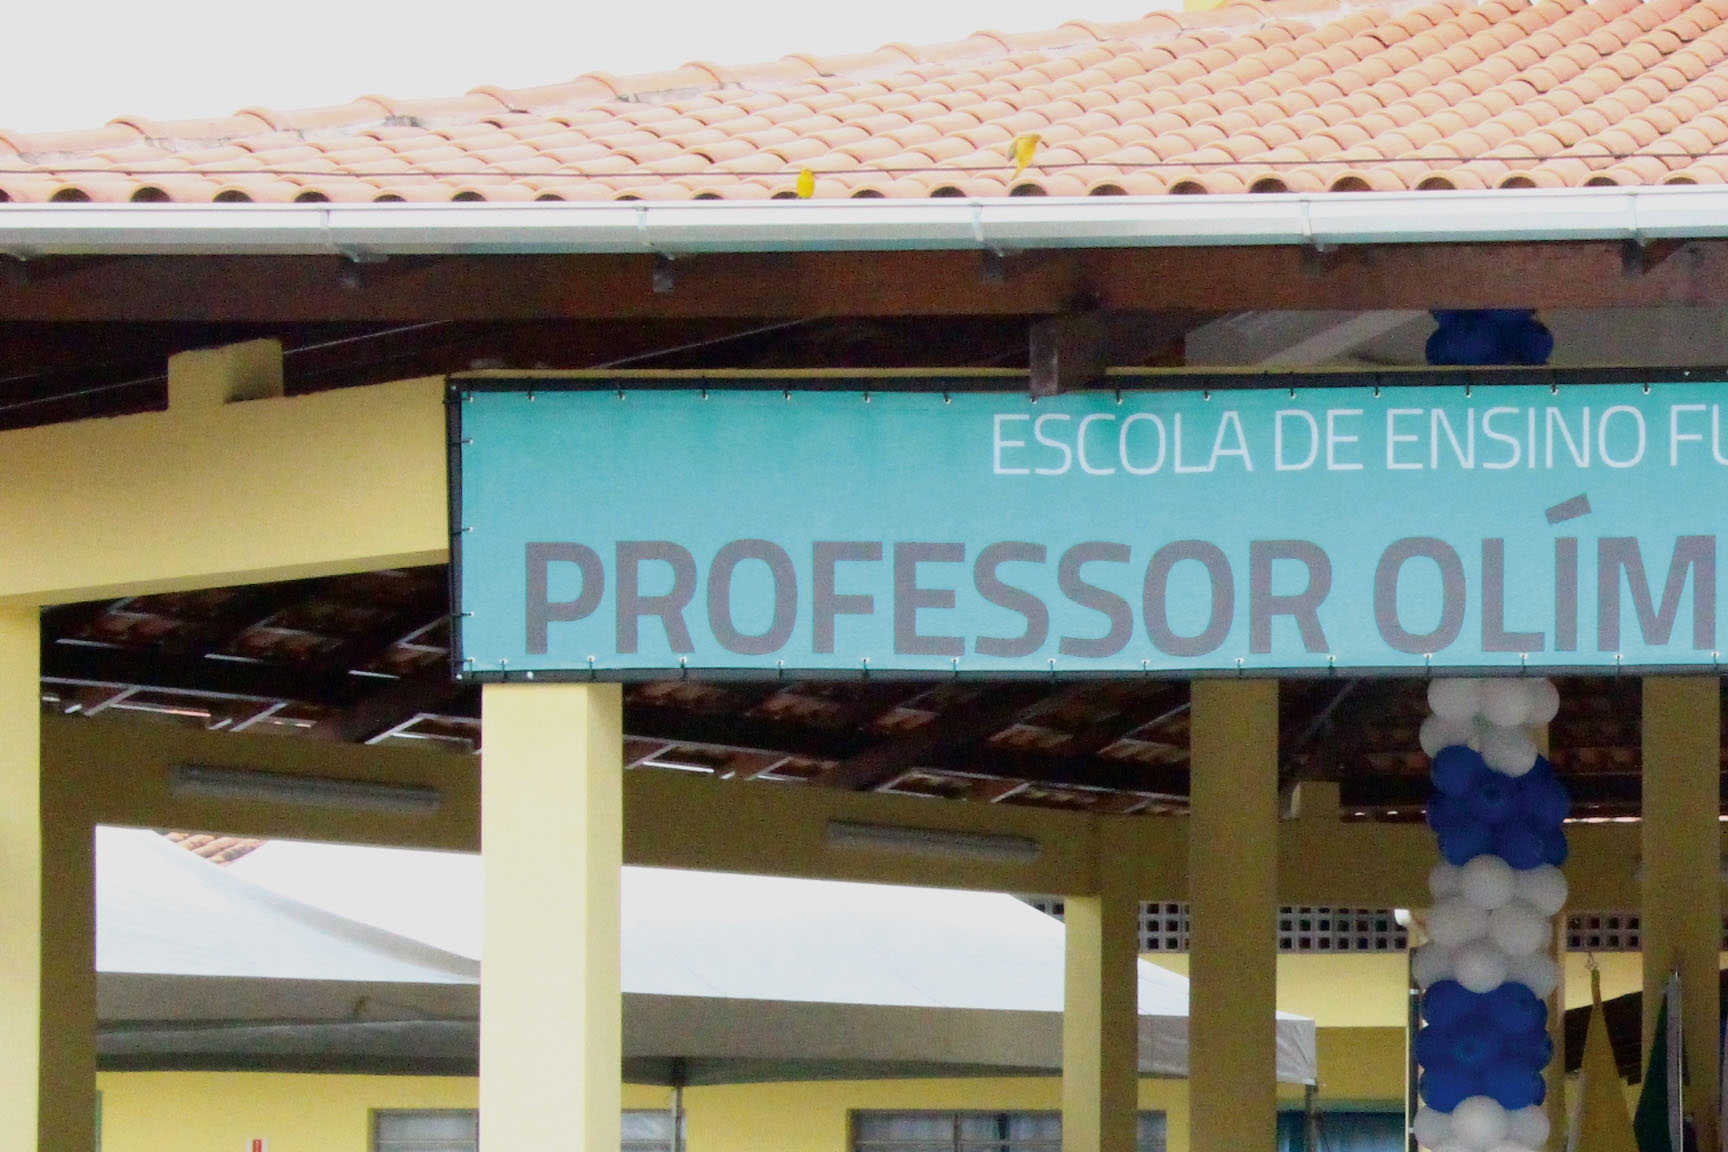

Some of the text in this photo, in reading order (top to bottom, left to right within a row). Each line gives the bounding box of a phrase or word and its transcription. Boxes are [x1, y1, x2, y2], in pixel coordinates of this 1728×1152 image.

[991, 409, 1254, 477] ESCOLA
[1273, 408, 1365, 473] DE
[1385, 404, 1648, 471] ENSINO
[523, 536, 1334, 657] PROFESSOR
